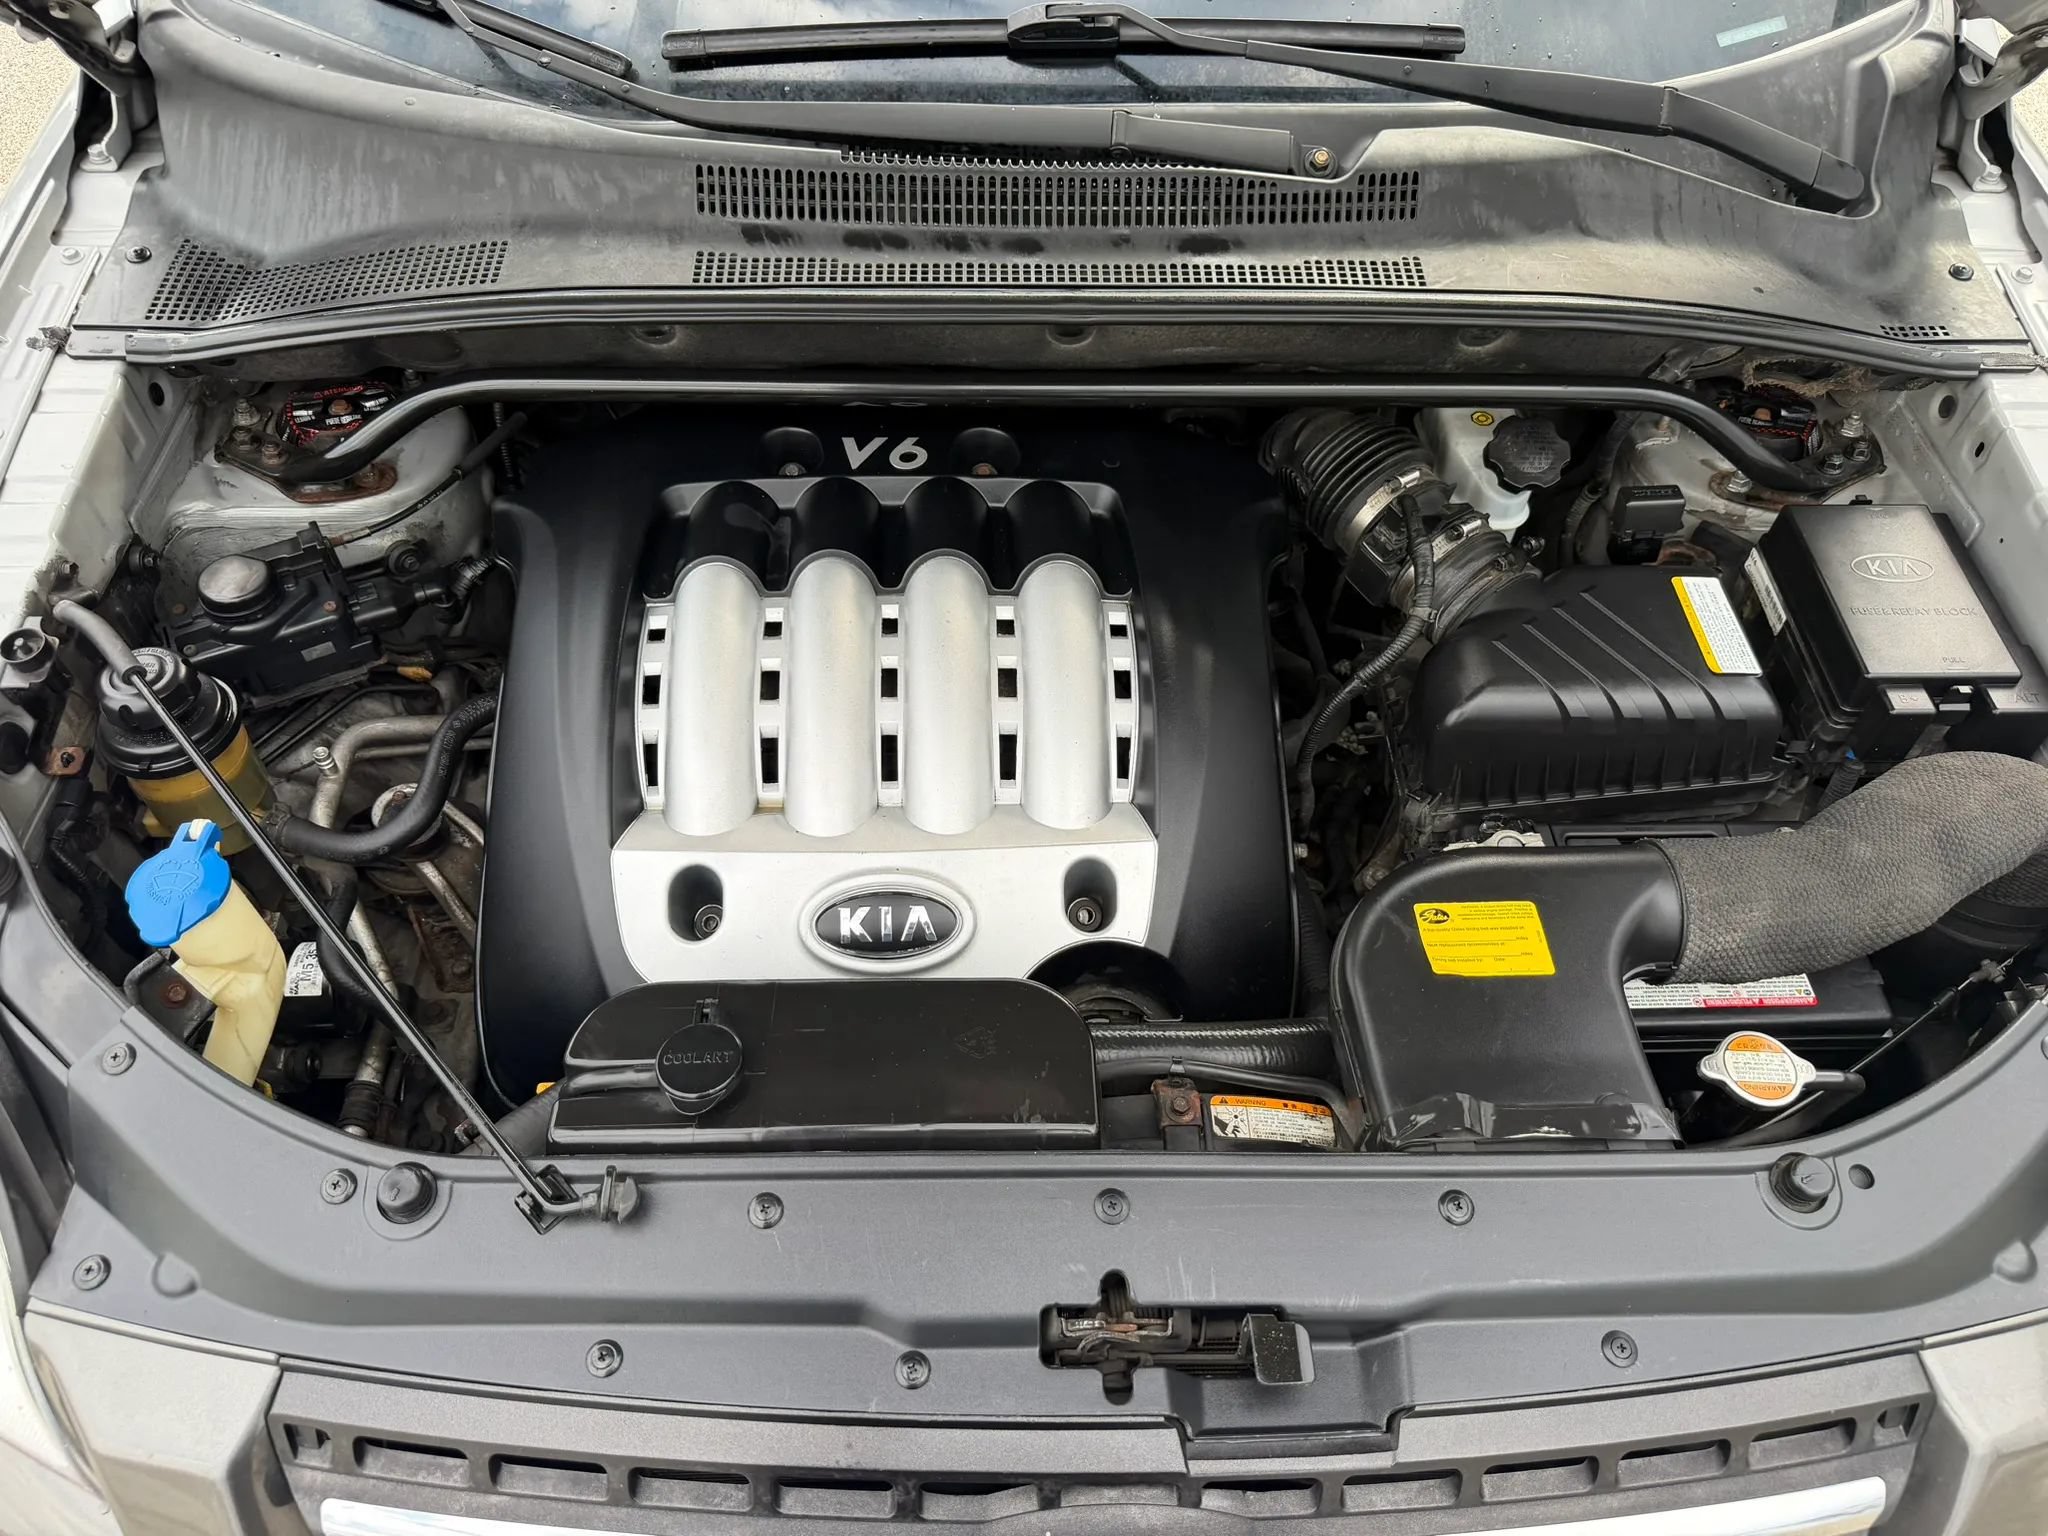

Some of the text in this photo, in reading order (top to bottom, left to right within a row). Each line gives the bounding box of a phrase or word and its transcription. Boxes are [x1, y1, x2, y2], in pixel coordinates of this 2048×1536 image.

[841, 437, 928, 470] V6
[1865, 559, 1922, 577] KIA
[1933, 607, 1979, 617] BLOCK
[837, 904, 938, 945] KIA
[663, 1050, 734, 1066] COOLANT
[1235, 1098, 1266, 1107] WARNING
